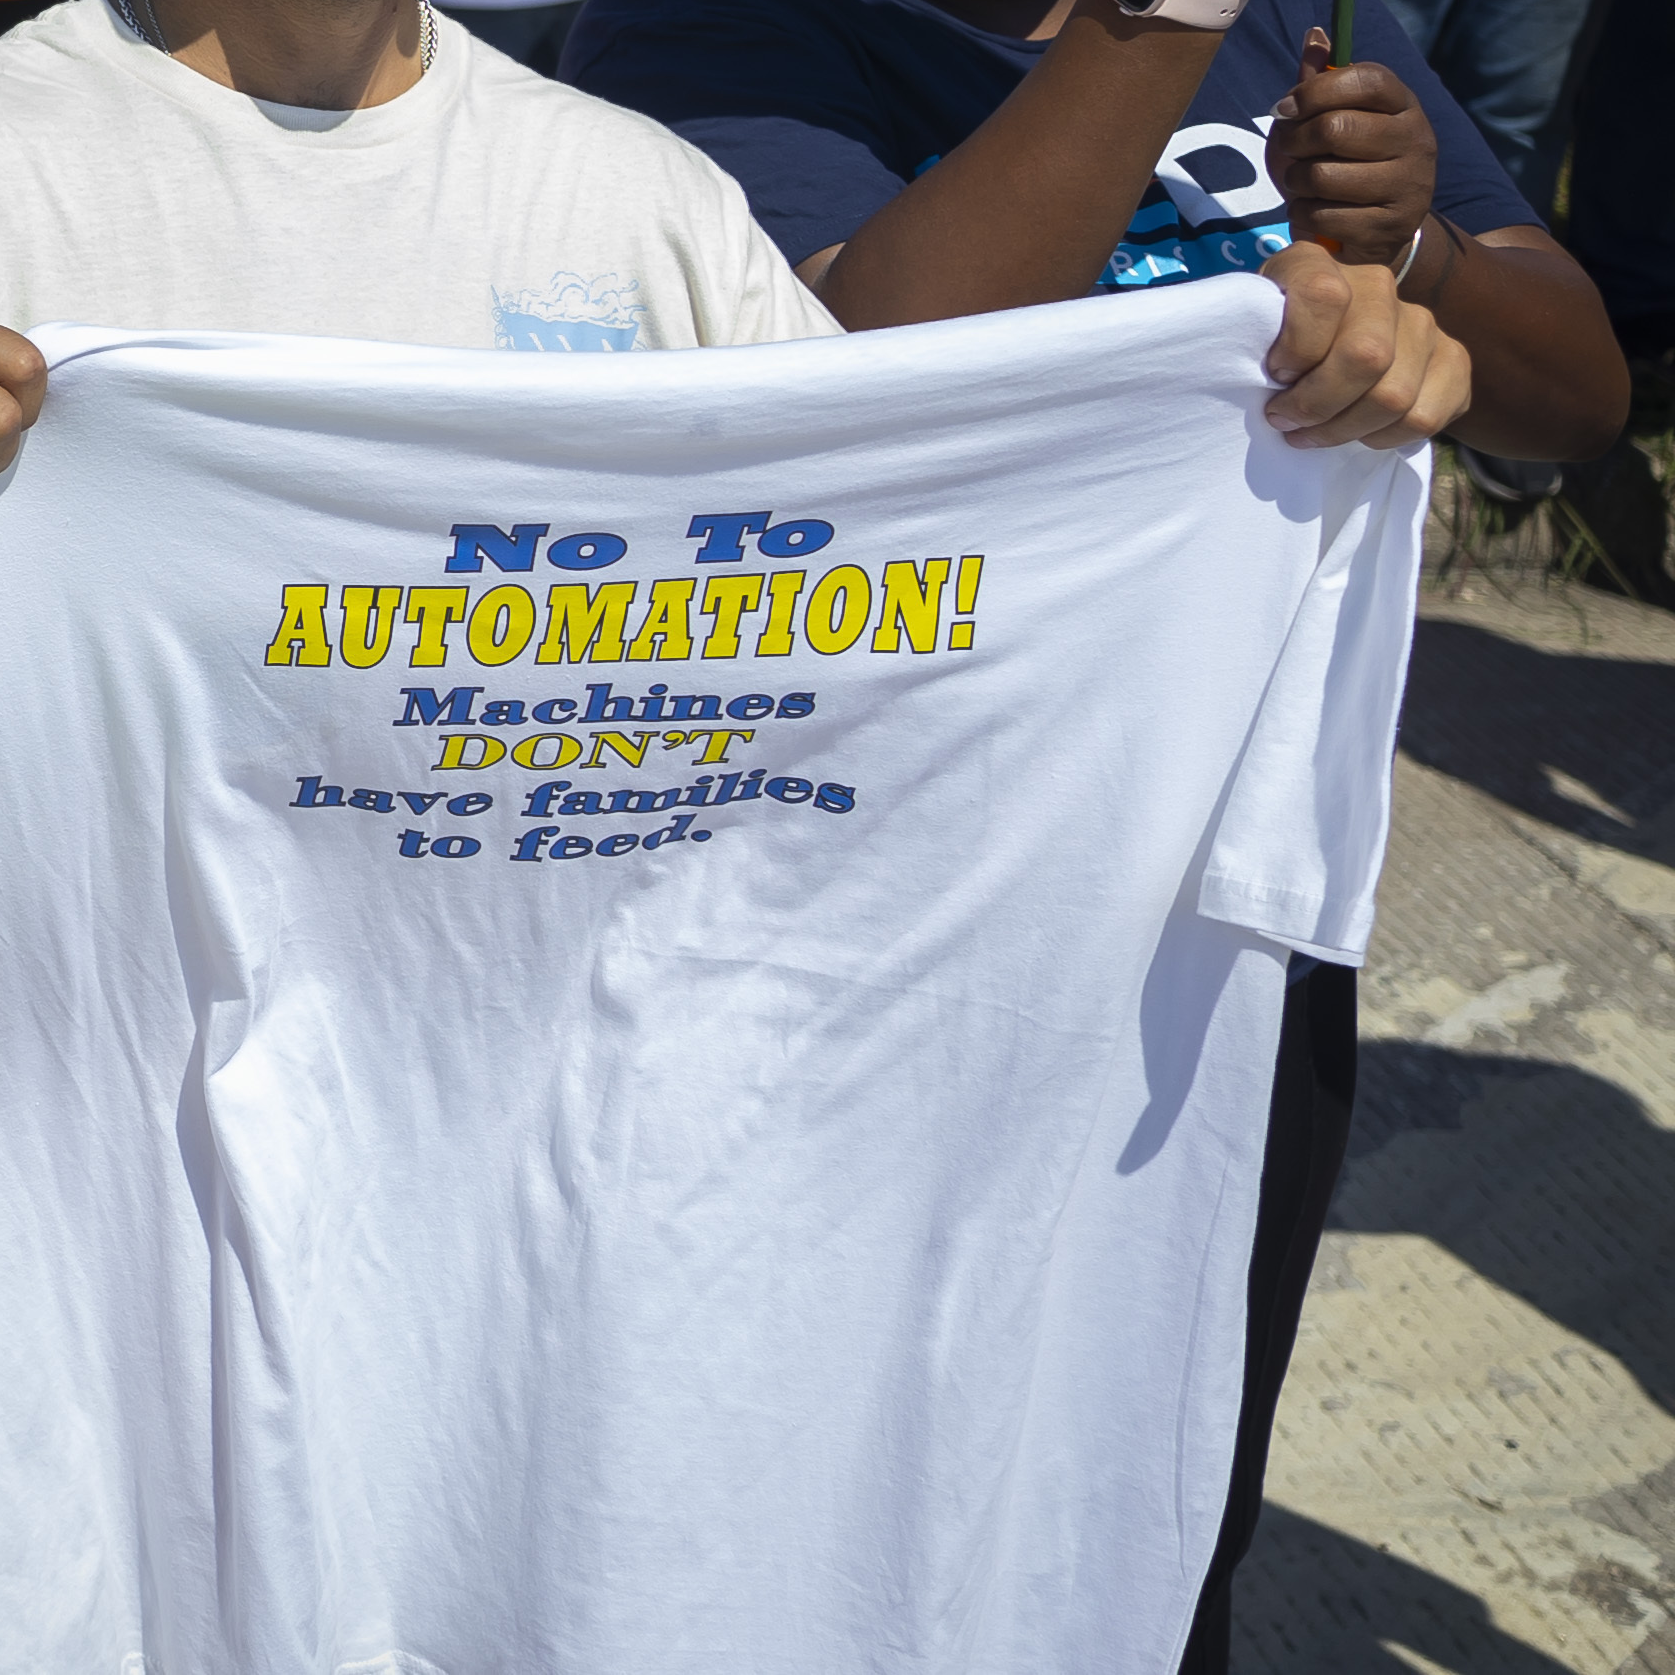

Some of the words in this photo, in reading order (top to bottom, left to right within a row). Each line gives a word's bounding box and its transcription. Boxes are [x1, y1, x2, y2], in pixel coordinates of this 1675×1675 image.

[444, 522, 628, 574] No
[687, 510, 836, 565] To
[263, 554, 986, 669] AUTOMATION!
[391, 683, 817, 727] Machines
[288, 776, 494, 818] have
[520, 767, 857, 819] families
[396, 828, 482, 860] to
[509, 813, 715, 864] feed.
